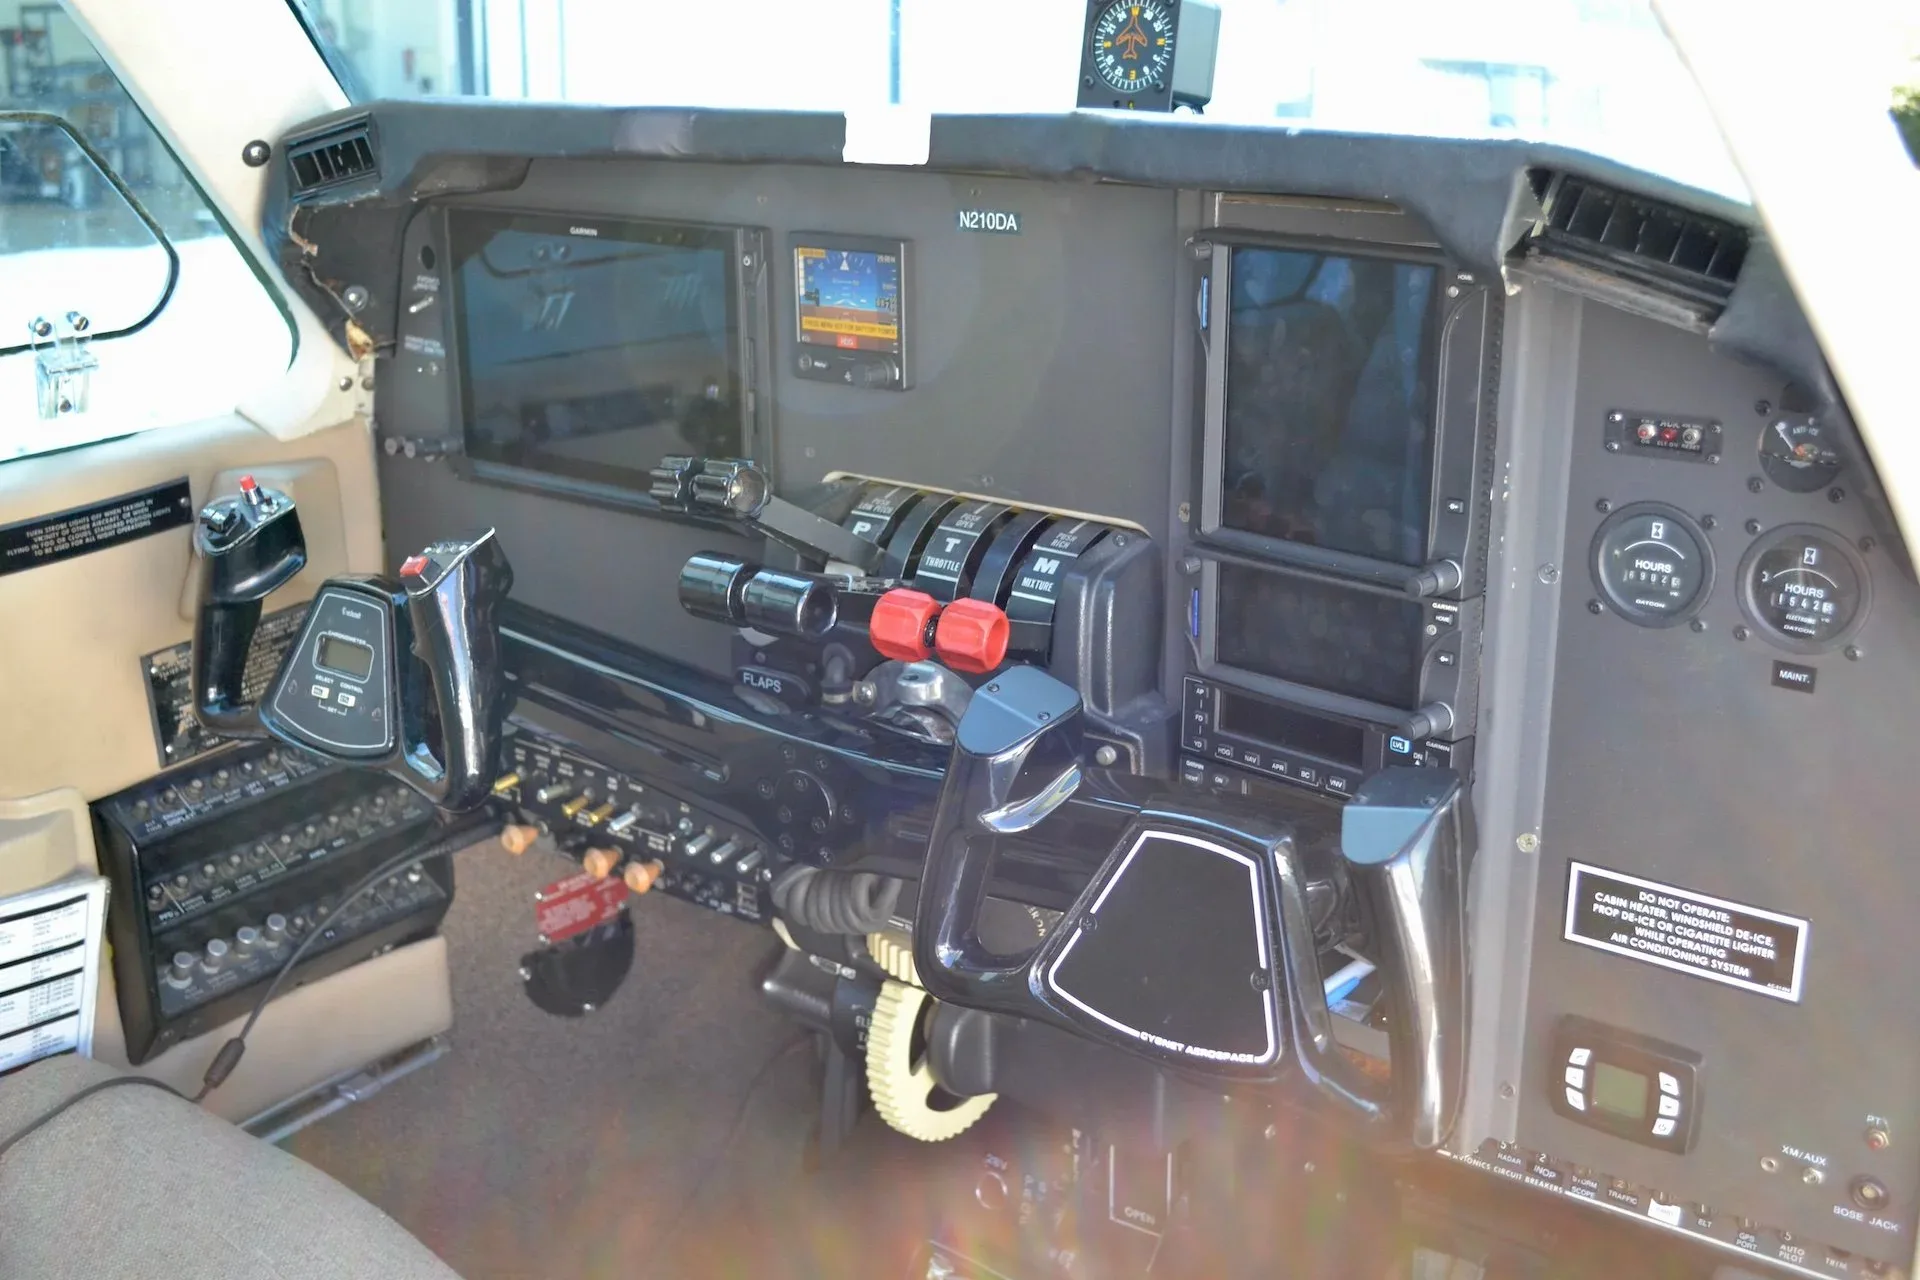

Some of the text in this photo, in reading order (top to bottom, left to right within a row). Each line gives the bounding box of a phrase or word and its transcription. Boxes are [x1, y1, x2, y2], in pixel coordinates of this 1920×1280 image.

[1131, 7, 1139, 16] W
[1130, 70, 1136, 80] E
[960, 211, 1017, 231] N210DA
[851, 521, 872, 536] P
[955, 519, 976, 529] OPEN
[1055, 532, 1078, 542] PUSH
[945, 537, 962, 553] T
[925, 556, 961, 572] THROTTLE
[1032, 557, 1061, 575] M
[1635, 559, 1673, 573] HOURS
[1021, 577, 1054, 592] MIXTURE
[1784, 583, 1825, 599] HOURS
[1432, 602, 1458, 613] GARMIN
[1635, 598, 1667, 609] DATCON
[1783, 624, 1816, 635] DATCON
[743, 671, 783, 694] FLAPS
[1779, 670, 1811, 684] MAINT.
[1195, 713, 1204, 722] FD
[1392, 740, 1404, 750] LVL
[1425, 740, 1451, 753] GARMIN
[1244, 754, 1258, 764] NAV
[1271, 762, 1285, 772] APR
[1300, 770, 1311, 779] BC
[1329, 778, 1343, 788] VNV
[1639, 891, 1731, 923] DO NOT OPERATE:
[1594, 892, 1775, 948] CABIN HEATER, WINDSHIELD DE-ICE,
[1592, 903, 1776, 960] PROP DE-ICE OR CIGARETTE LIGHTER
[1634, 926, 1727, 959] WHILE OPERATING
[1610, 932, 1751, 978] AIR CONDITIONING SYSTEM
[1140, 1031, 1254, 1063] CYGNET AEROSPACE
[1538, 1153, 1546, 1163] 2
[1781, 1144, 1827, 1166] XM/AUX
[1533, 1165, 1557, 1179] INOP
[1493, 1166, 1523, 1181] CIRCUIT
[1524, 1175, 1564, 1194] BREAKERS
[1571, 1185, 1597, 1200] SCOPE
[1608, 1189, 1638, 1206] TRAFFIC
[1124, 1206, 1156, 1225] OPEN
[1832, 1205, 1899, 1232] BOSE JACK
[1698, 1218, 1712, 1229] ELT
[1738, 1232, 1756, 1243] GPS
[1736, 1239, 1758, 1251] PORT
[1779, 1243, 1806, 1256] AUTO
[1778, 1250, 1803, 1263] PILOT
